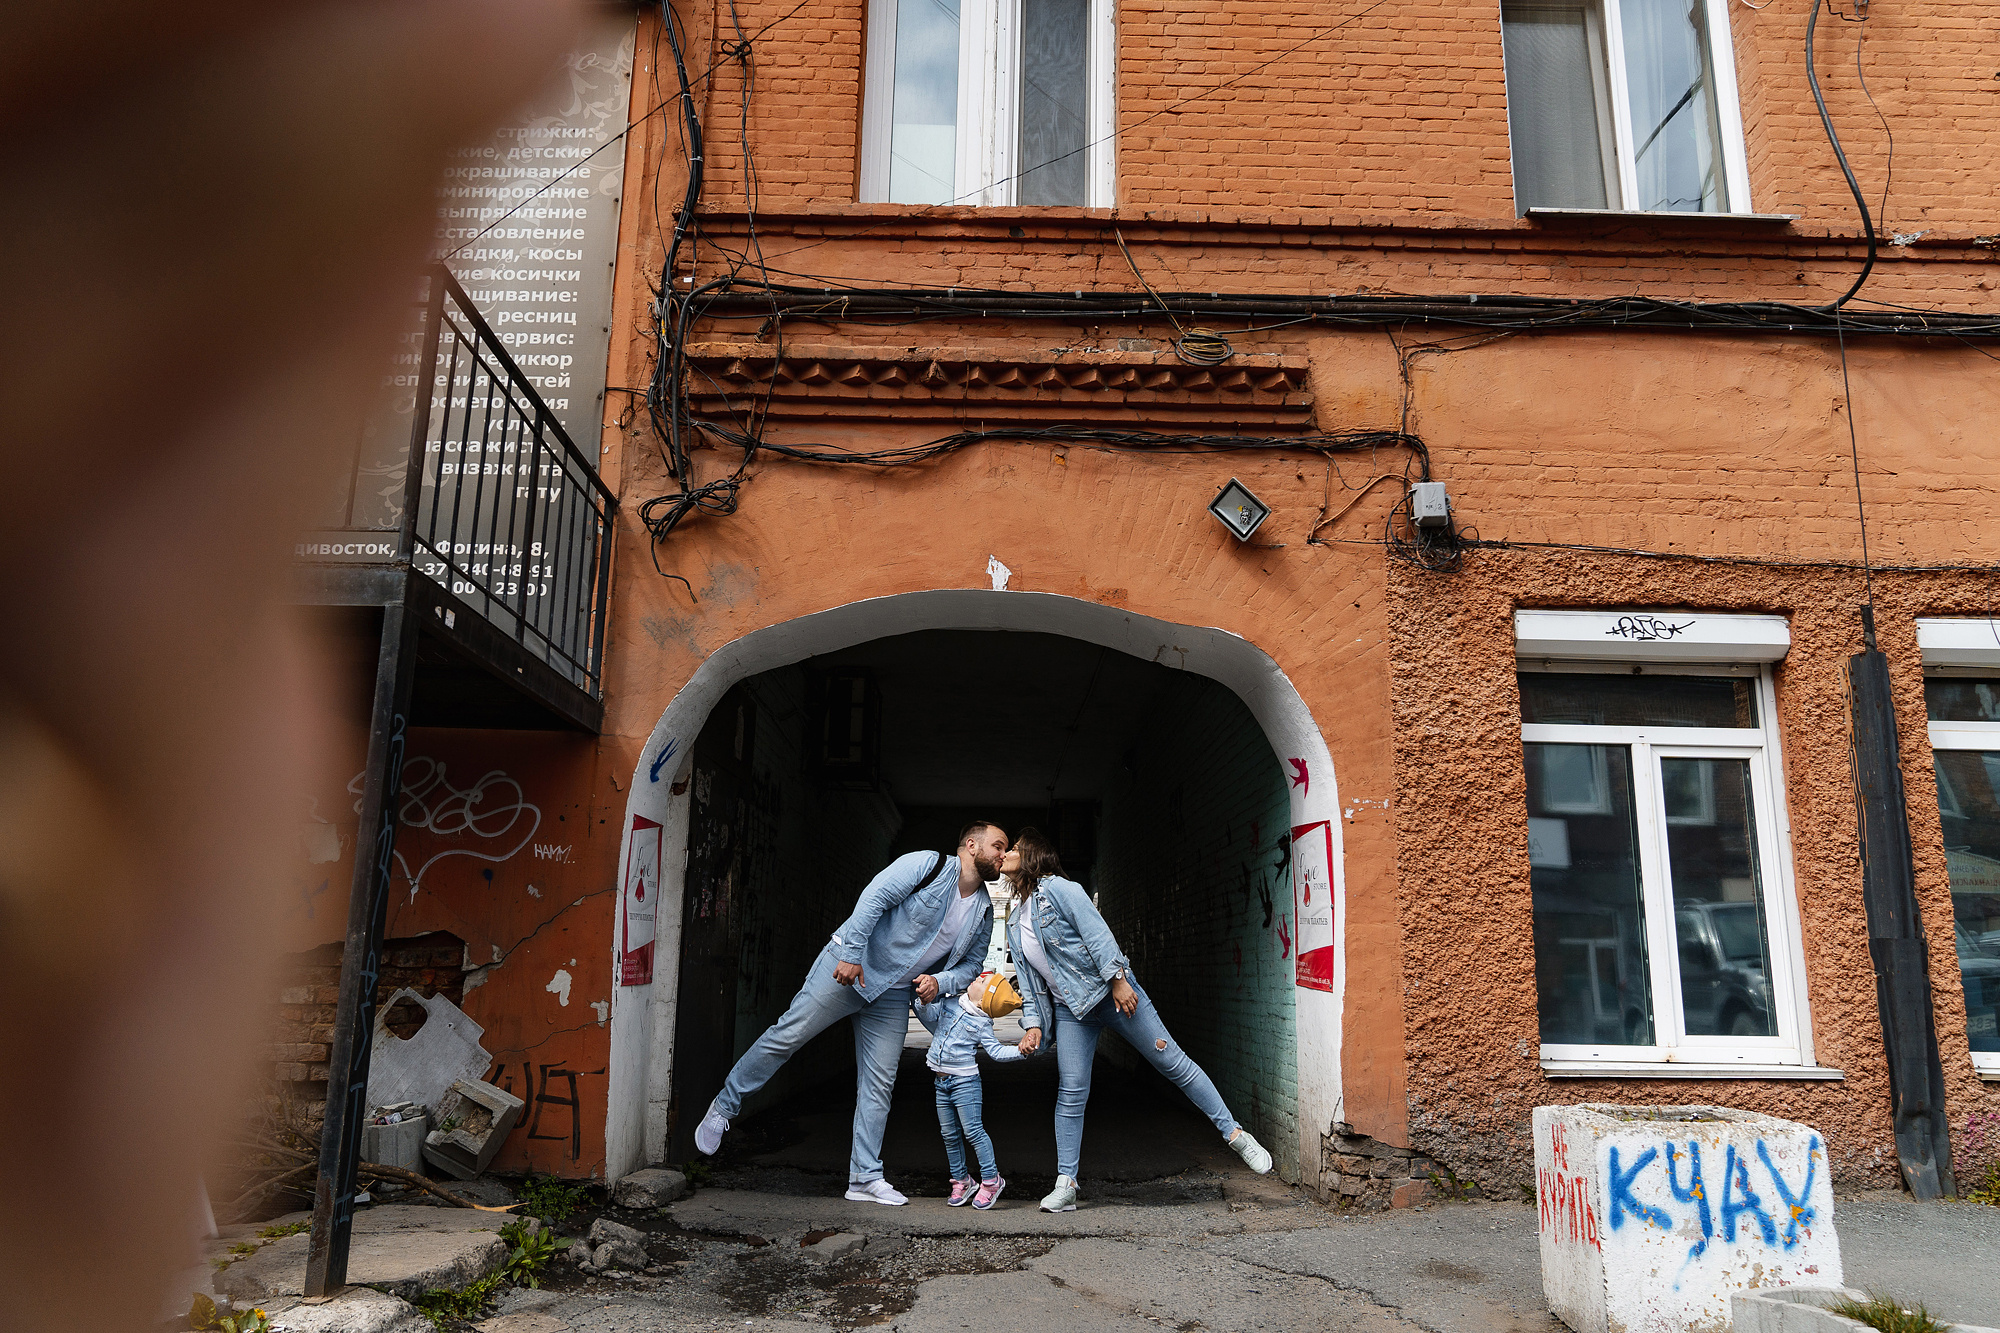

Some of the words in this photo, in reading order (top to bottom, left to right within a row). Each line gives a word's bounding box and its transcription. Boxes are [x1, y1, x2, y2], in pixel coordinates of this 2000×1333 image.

[507, 147, 592, 160] детские
[444, 167, 591, 181] окрашивание
[437, 207, 587, 221] выпрямление
[528, 249, 583, 261] косы
[490, 269, 581, 281] косички
[497, 311, 577, 325] ресниц
[1551, 1122, 1568, 1171] НЕ
